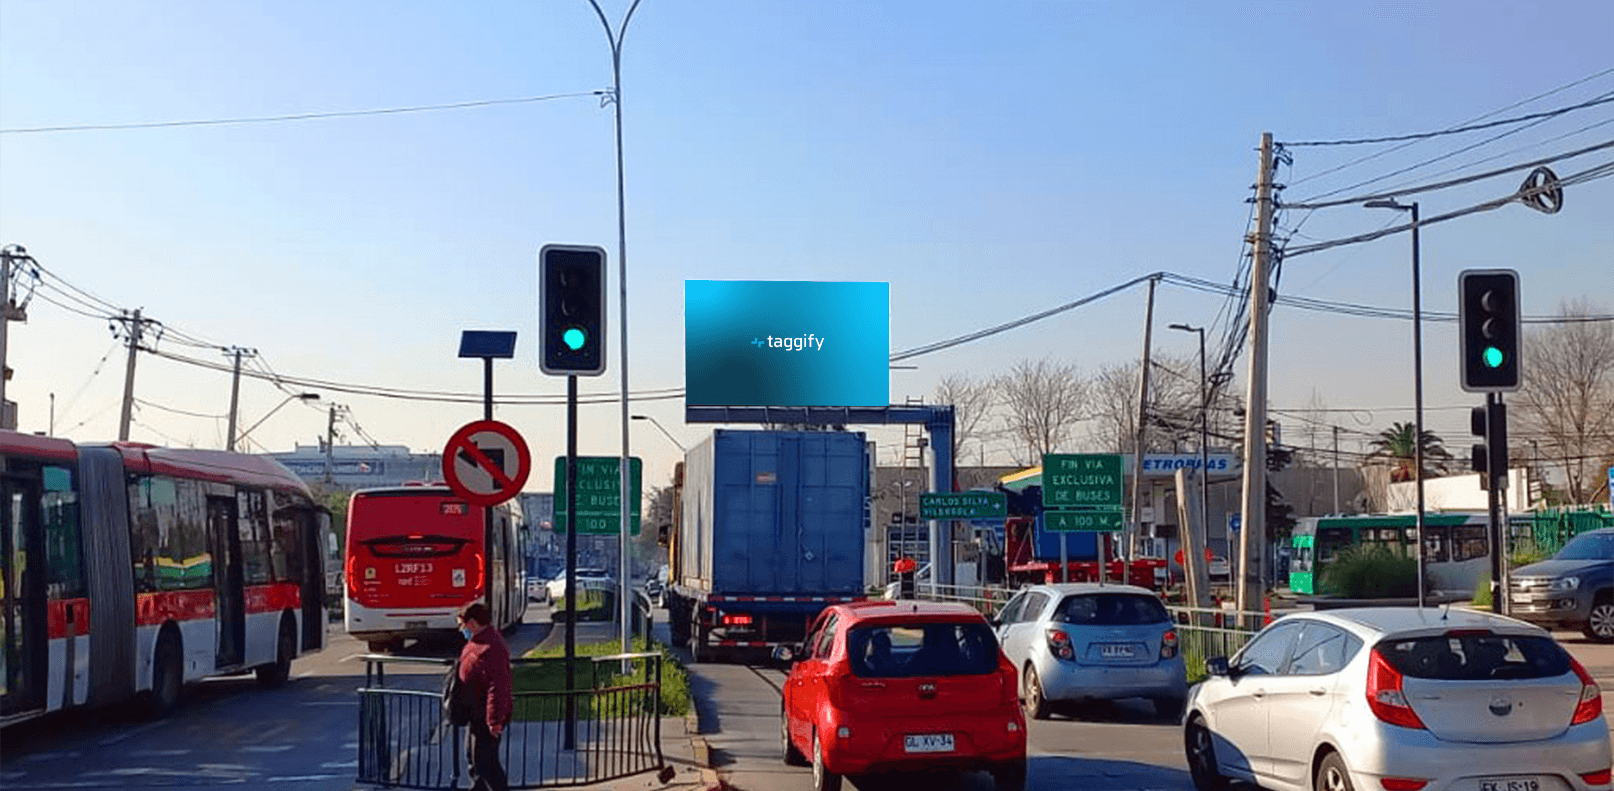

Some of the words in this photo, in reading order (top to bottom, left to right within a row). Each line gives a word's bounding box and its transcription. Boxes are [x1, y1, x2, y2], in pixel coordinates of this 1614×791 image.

[767, 333, 824, 351] taggify
[1061, 460, 1078, 469] FIN
[1086, 460, 1104, 469] VIA
[1052, 475, 1114, 485] EXCLUSIVA
[1055, 491, 1069, 501] DE
[1075, 491, 1110, 501] BUSES
[1059, 516, 1067, 526] A
[1075, 516, 1093, 525] 100
